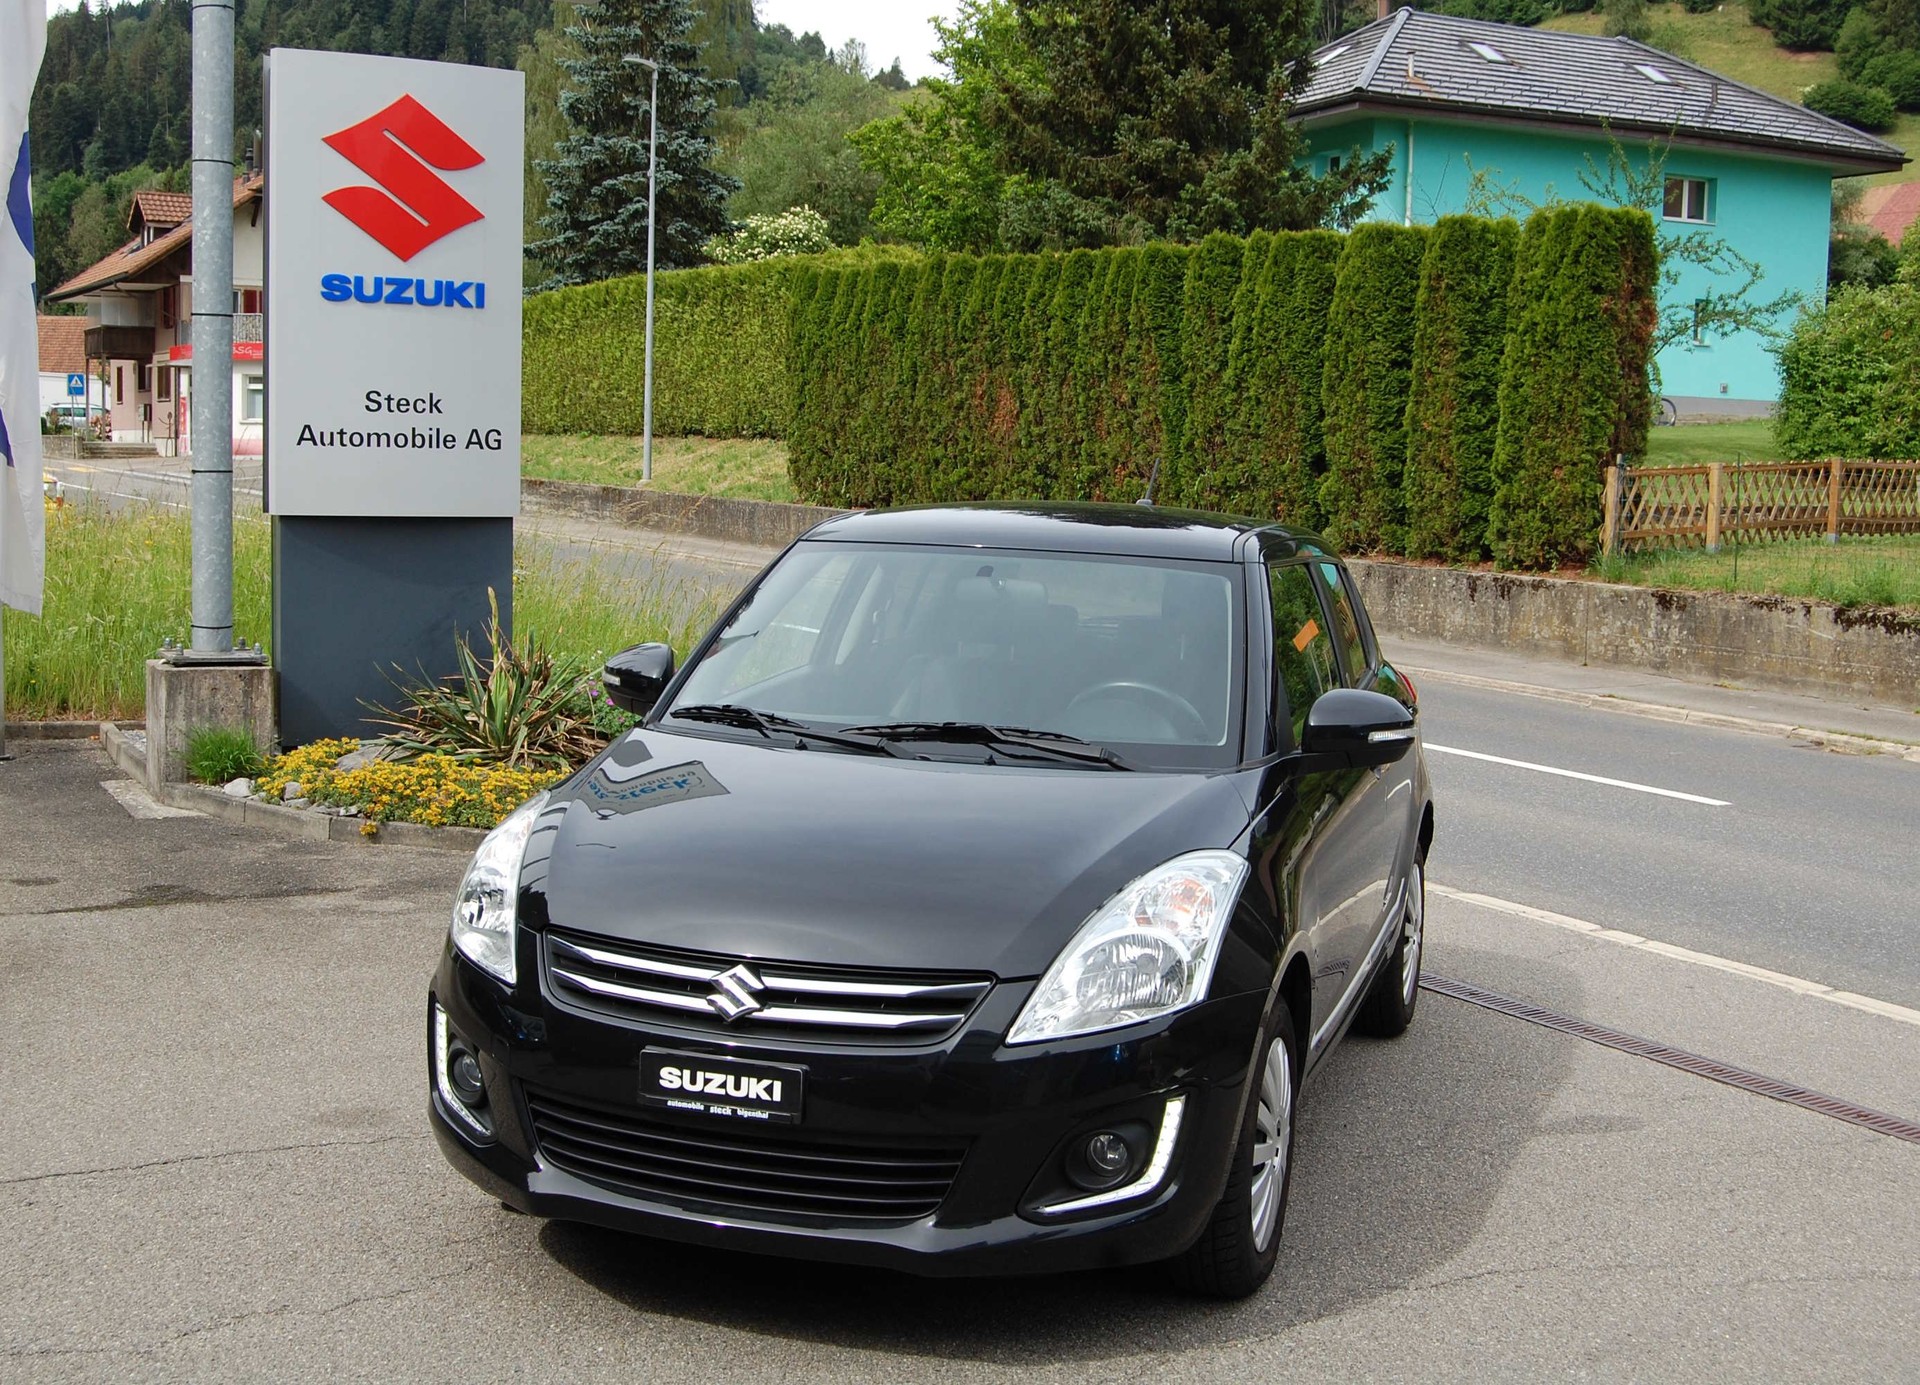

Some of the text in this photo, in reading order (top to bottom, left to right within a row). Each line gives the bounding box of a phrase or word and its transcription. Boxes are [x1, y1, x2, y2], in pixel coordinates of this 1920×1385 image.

[320, 273, 486, 310] SUZUKI
[364, 390, 443, 414] Steck
[296, 424, 502, 450] Automobile AG
[659, 1066, 782, 1102] SUZUKI
[667, 1099, 704, 1111] automobile
[709, 1105, 732, 1116] steck
